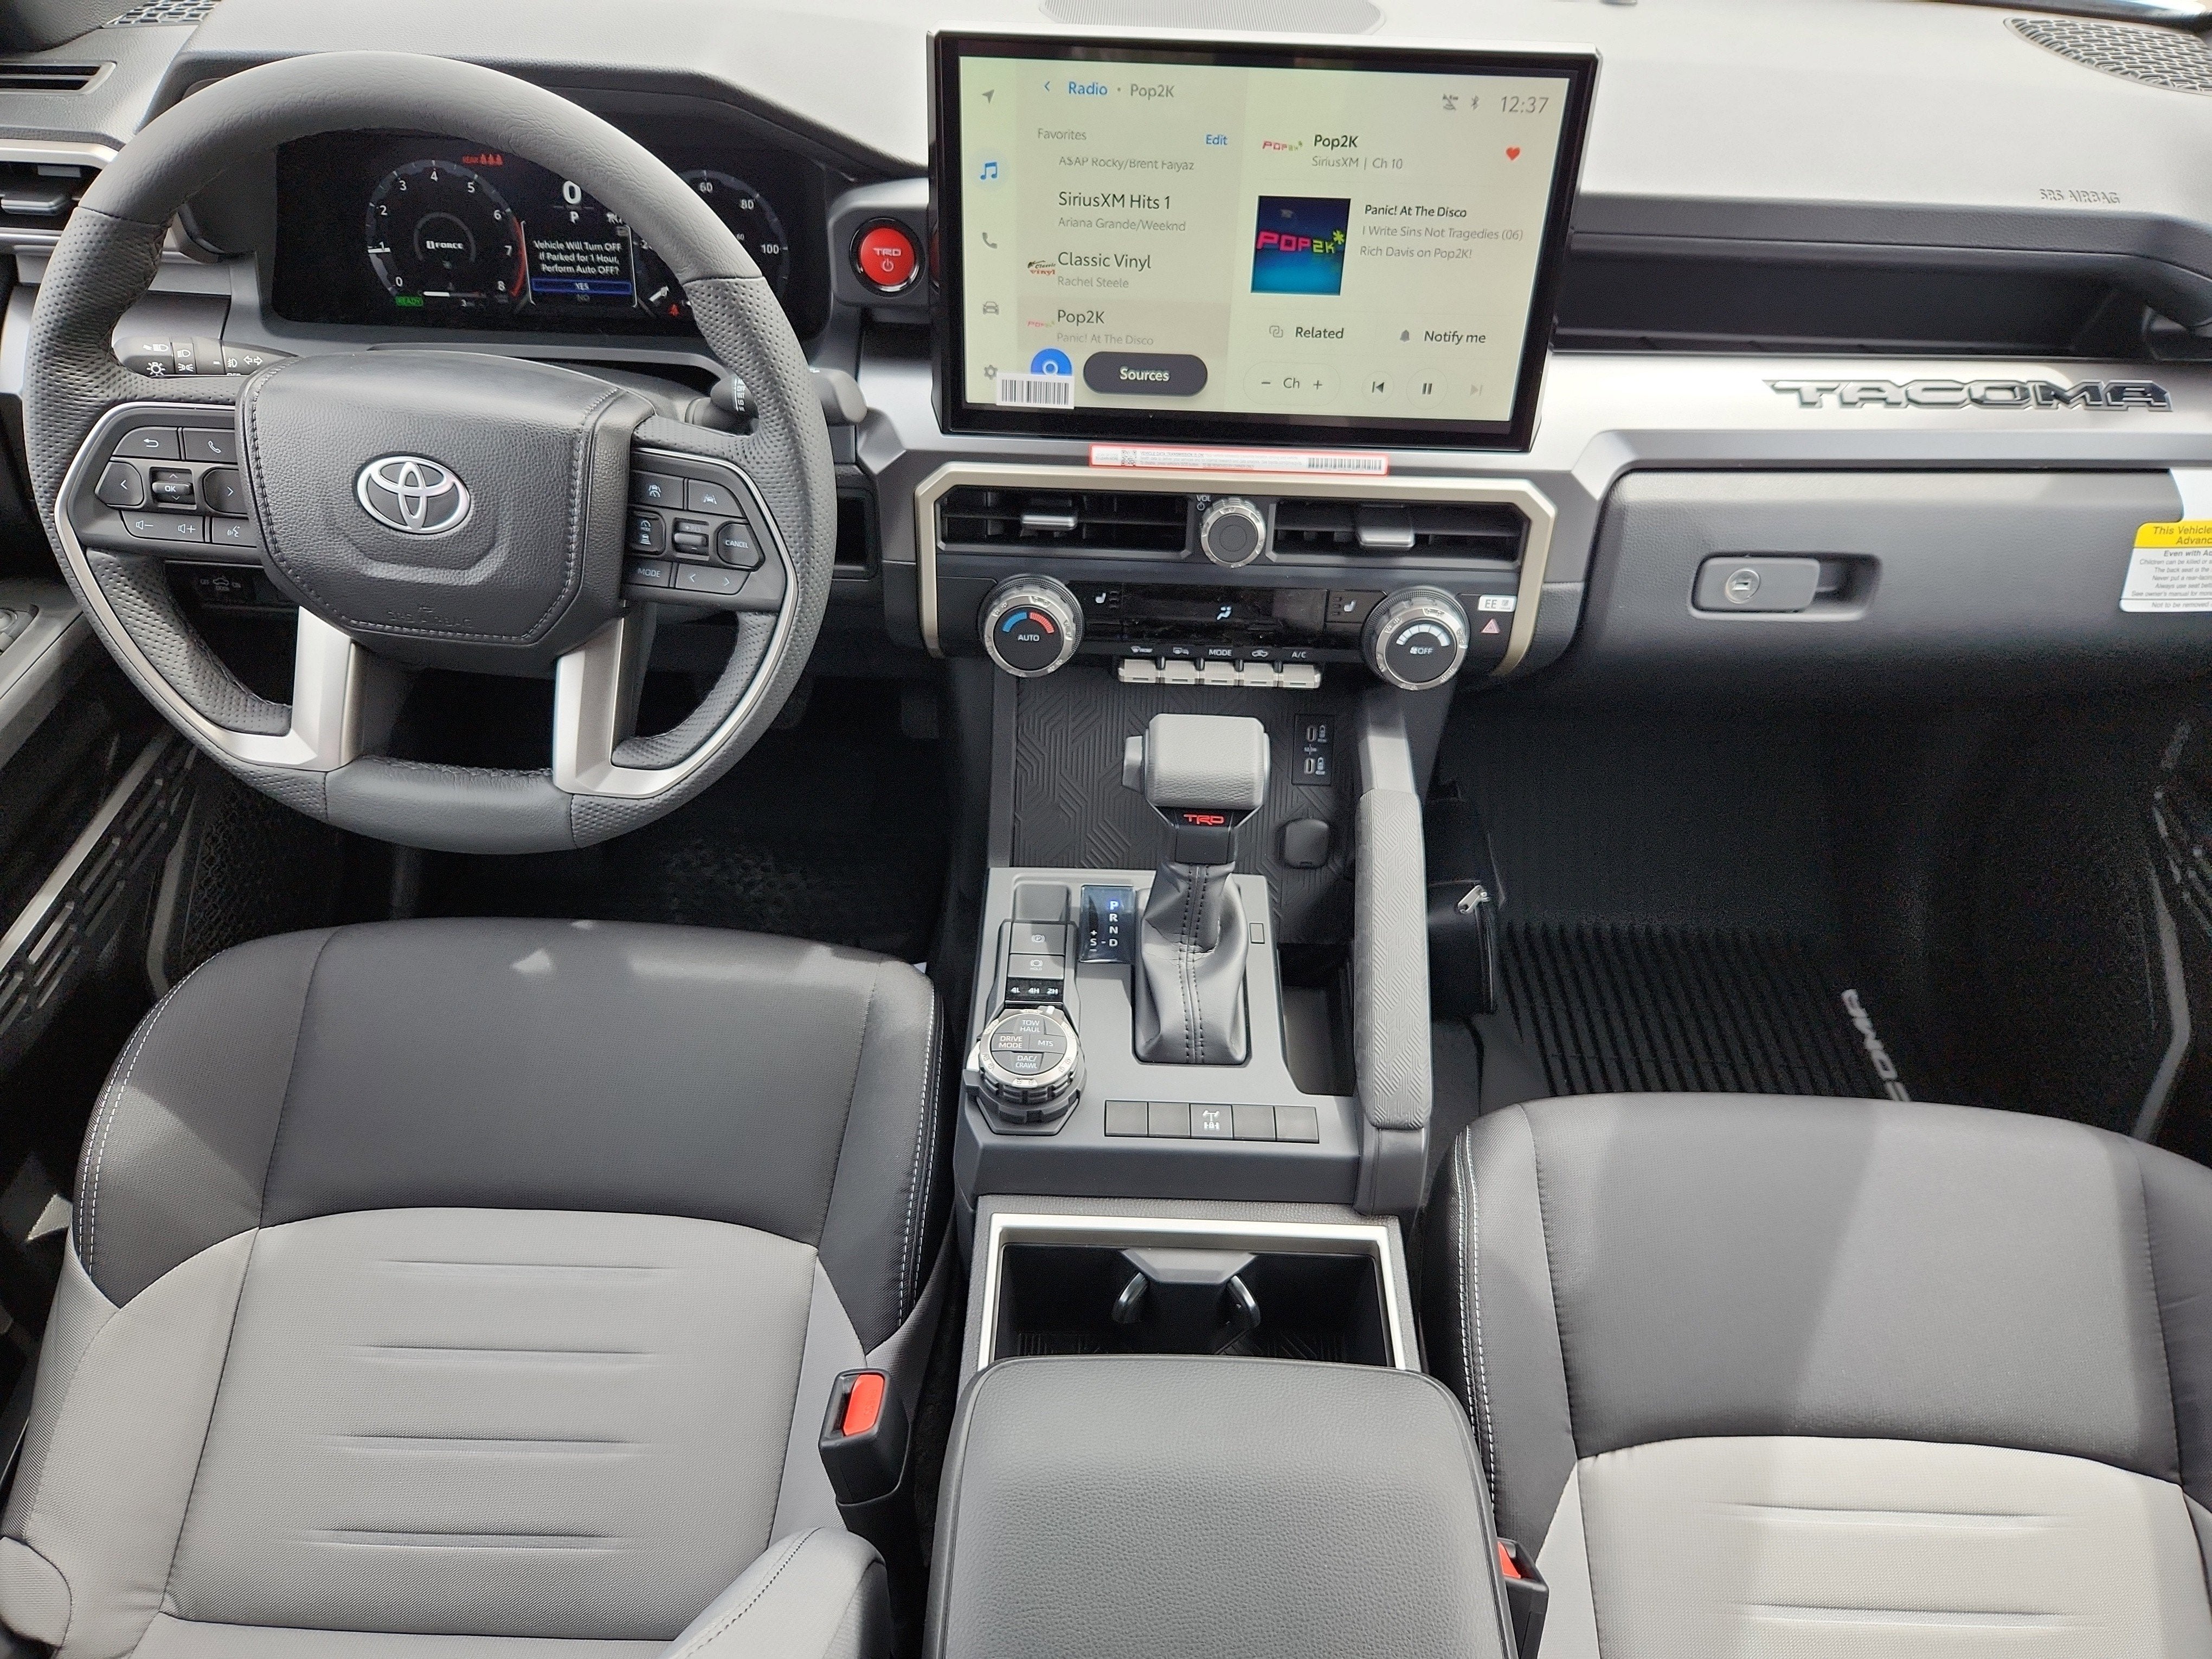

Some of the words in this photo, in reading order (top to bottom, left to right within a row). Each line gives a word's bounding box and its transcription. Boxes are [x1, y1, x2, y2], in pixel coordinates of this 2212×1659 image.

[1068, 81, 1108, 96] Radio
[1130, 83, 1175, 100] Pop2K
[1501, 96, 1549, 113] 12:37
[1038, 128, 1087, 141] Favorites
[1206, 134, 1228, 146] Edit
[1314, 134, 1359, 149] Pop2K
[1311, 156, 1359, 168] SiriusXM
[1372, 157, 1388, 169] Ch
[1392, 158, 1403, 170] 10
[430, 171, 438, 182] 4
[400, 181, 407, 191] 3
[467, 182, 475, 193] 5
[699, 182, 713, 193] 60
[562, 181, 582, 204] 0
[2039, 189, 2064, 201] SRS
[2068, 190, 2120, 204] AIRBAG
[1058, 191, 1125, 208] SiriusXM
[1130, 194, 1160, 209] Hits
[1165, 196, 1170, 209] 1
[380, 205, 388, 216] 2
[494, 209, 501, 220] 6
[1365, 205, 1398, 216] Panic!
[1400, 206, 1412, 216] At
[1414, 206, 1435, 216] The
[1437, 207, 1467, 217] Disco
[570, 211, 579, 223] P
[1058, 218, 1092, 228] Ariana
[1096, 218, 1186, 232] Grande/Weeknd
[1368, 226, 1397, 236] Write
[1400, 227, 1422, 236] Sins
[1425, 227, 1446, 237] Not
[1448, 228, 1499, 241] Tragedies
[1502, 229, 1523, 241] (06)
[504, 246, 512, 256] 7
[533, 240, 565, 250] Vehicle
[566, 241, 583, 251] Will
[583, 242, 603, 251] Turn
[605, 242, 622, 252] OFF
[761, 244, 779, 254] 100
[546, 252, 575, 262] Parked
[577, 253, 589, 262] for
[873, 248, 902, 256] TRD
[1360, 247, 1382, 256] Rich
[1386, 247, 1414, 258] Davis
[1417, 250, 1431, 258] on
[1434, 248, 1472, 261] Pop2K!
[1058, 252, 1110, 267] Classic
[1114, 254, 1152, 272] Vinyl
[541, 263, 575, 273] Perform
[576, 265, 596, 274] Auto
[395, 276, 403, 287] 0
[497, 281, 505, 291] 8
[1058, 276, 1094, 287] Rachel
[1096, 278, 1129, 288] Steele
[1057, 310, 1105, 326] Pop2K
[1057, 332, 1087, 343] Panic!
[1091, 334, 1101, 343] At
[1105, 335, 1122, 344] The
[1126, 335, 1154, 345] Disco
[1295, 327, 1344, 339] Related
[1424, 331, 1463, 345] Notify
[1465, 334, 1486, 344] me
[1120, 366, 1169, 381] Sources
[1283, 378, 1300, 389] Ch
[1762, 379, 2173, 412] TACOMA
[2153, 526, 2174, 535] This
[2178, 525, 2212, 534] Vehicle
[725, 540, 748, 549] CANCEL
[638, 568, 661, 578] MODE
[1484, 599, 1497, 609] EE
[1017, 634, 1040, 642] AUTO
[1184, 814, 1225, 825] TRD
[1110, 900, 1118, 910] P
[1109, 913, 1118, 922] R
[1109, 925, 1118, 934] N
[1090, 938, 1097, 947] S
[1109, 938, 1118, 947] D
